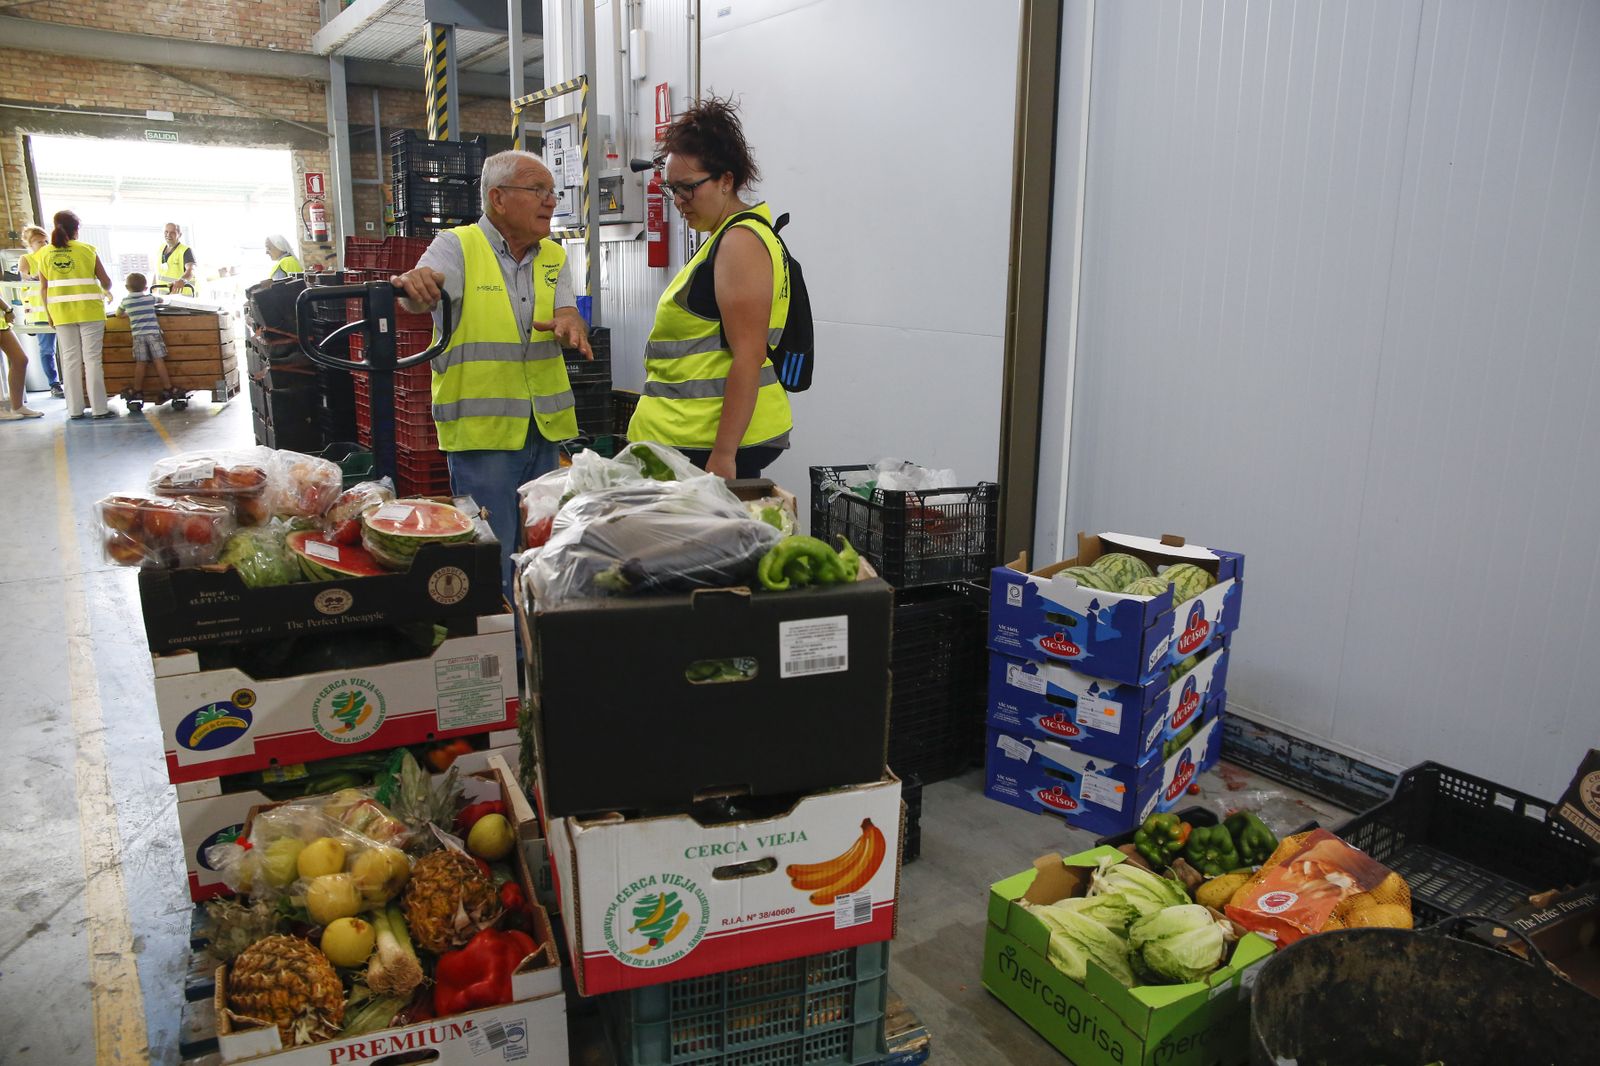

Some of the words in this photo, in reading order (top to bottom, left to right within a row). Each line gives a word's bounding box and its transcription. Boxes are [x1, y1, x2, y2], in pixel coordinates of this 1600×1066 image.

[147, 132, 177, 140] SALIDA
[286, 620, 304, 630] The
[307, 617, 338, 628] Perfect
[341, 610, 385, 624] Pineapple
[319, 679, 348, 699] CERCA
[349, 677, 376, 692] VIEJA
[684, 840, 748, 860] CERCA
[756, 830, 808, 849] VIEJA
[615, 875, 657, 904] CERCA
[661, 873, 697, 893] VIEJA
[721, 914, 745, 926] R.I.A.
[758, 906, 796, 921] 38/40606
[1514, 918, 1537, 931] The
[1531, 908, 1560, 924] Perfec
[607, 939, 620, 954] DEL
[618, 951, 633, 964] SUR
[632, 958, 643, 967] DE
[644, 958, 656, 967] LA
[657, 949, 686, 966] PALMA
[687, 925, 707, 949] SABOR
[998, 947, 1124, 1065] mercagrisa
[328, 1019, 474, 1066] PREMIUM
